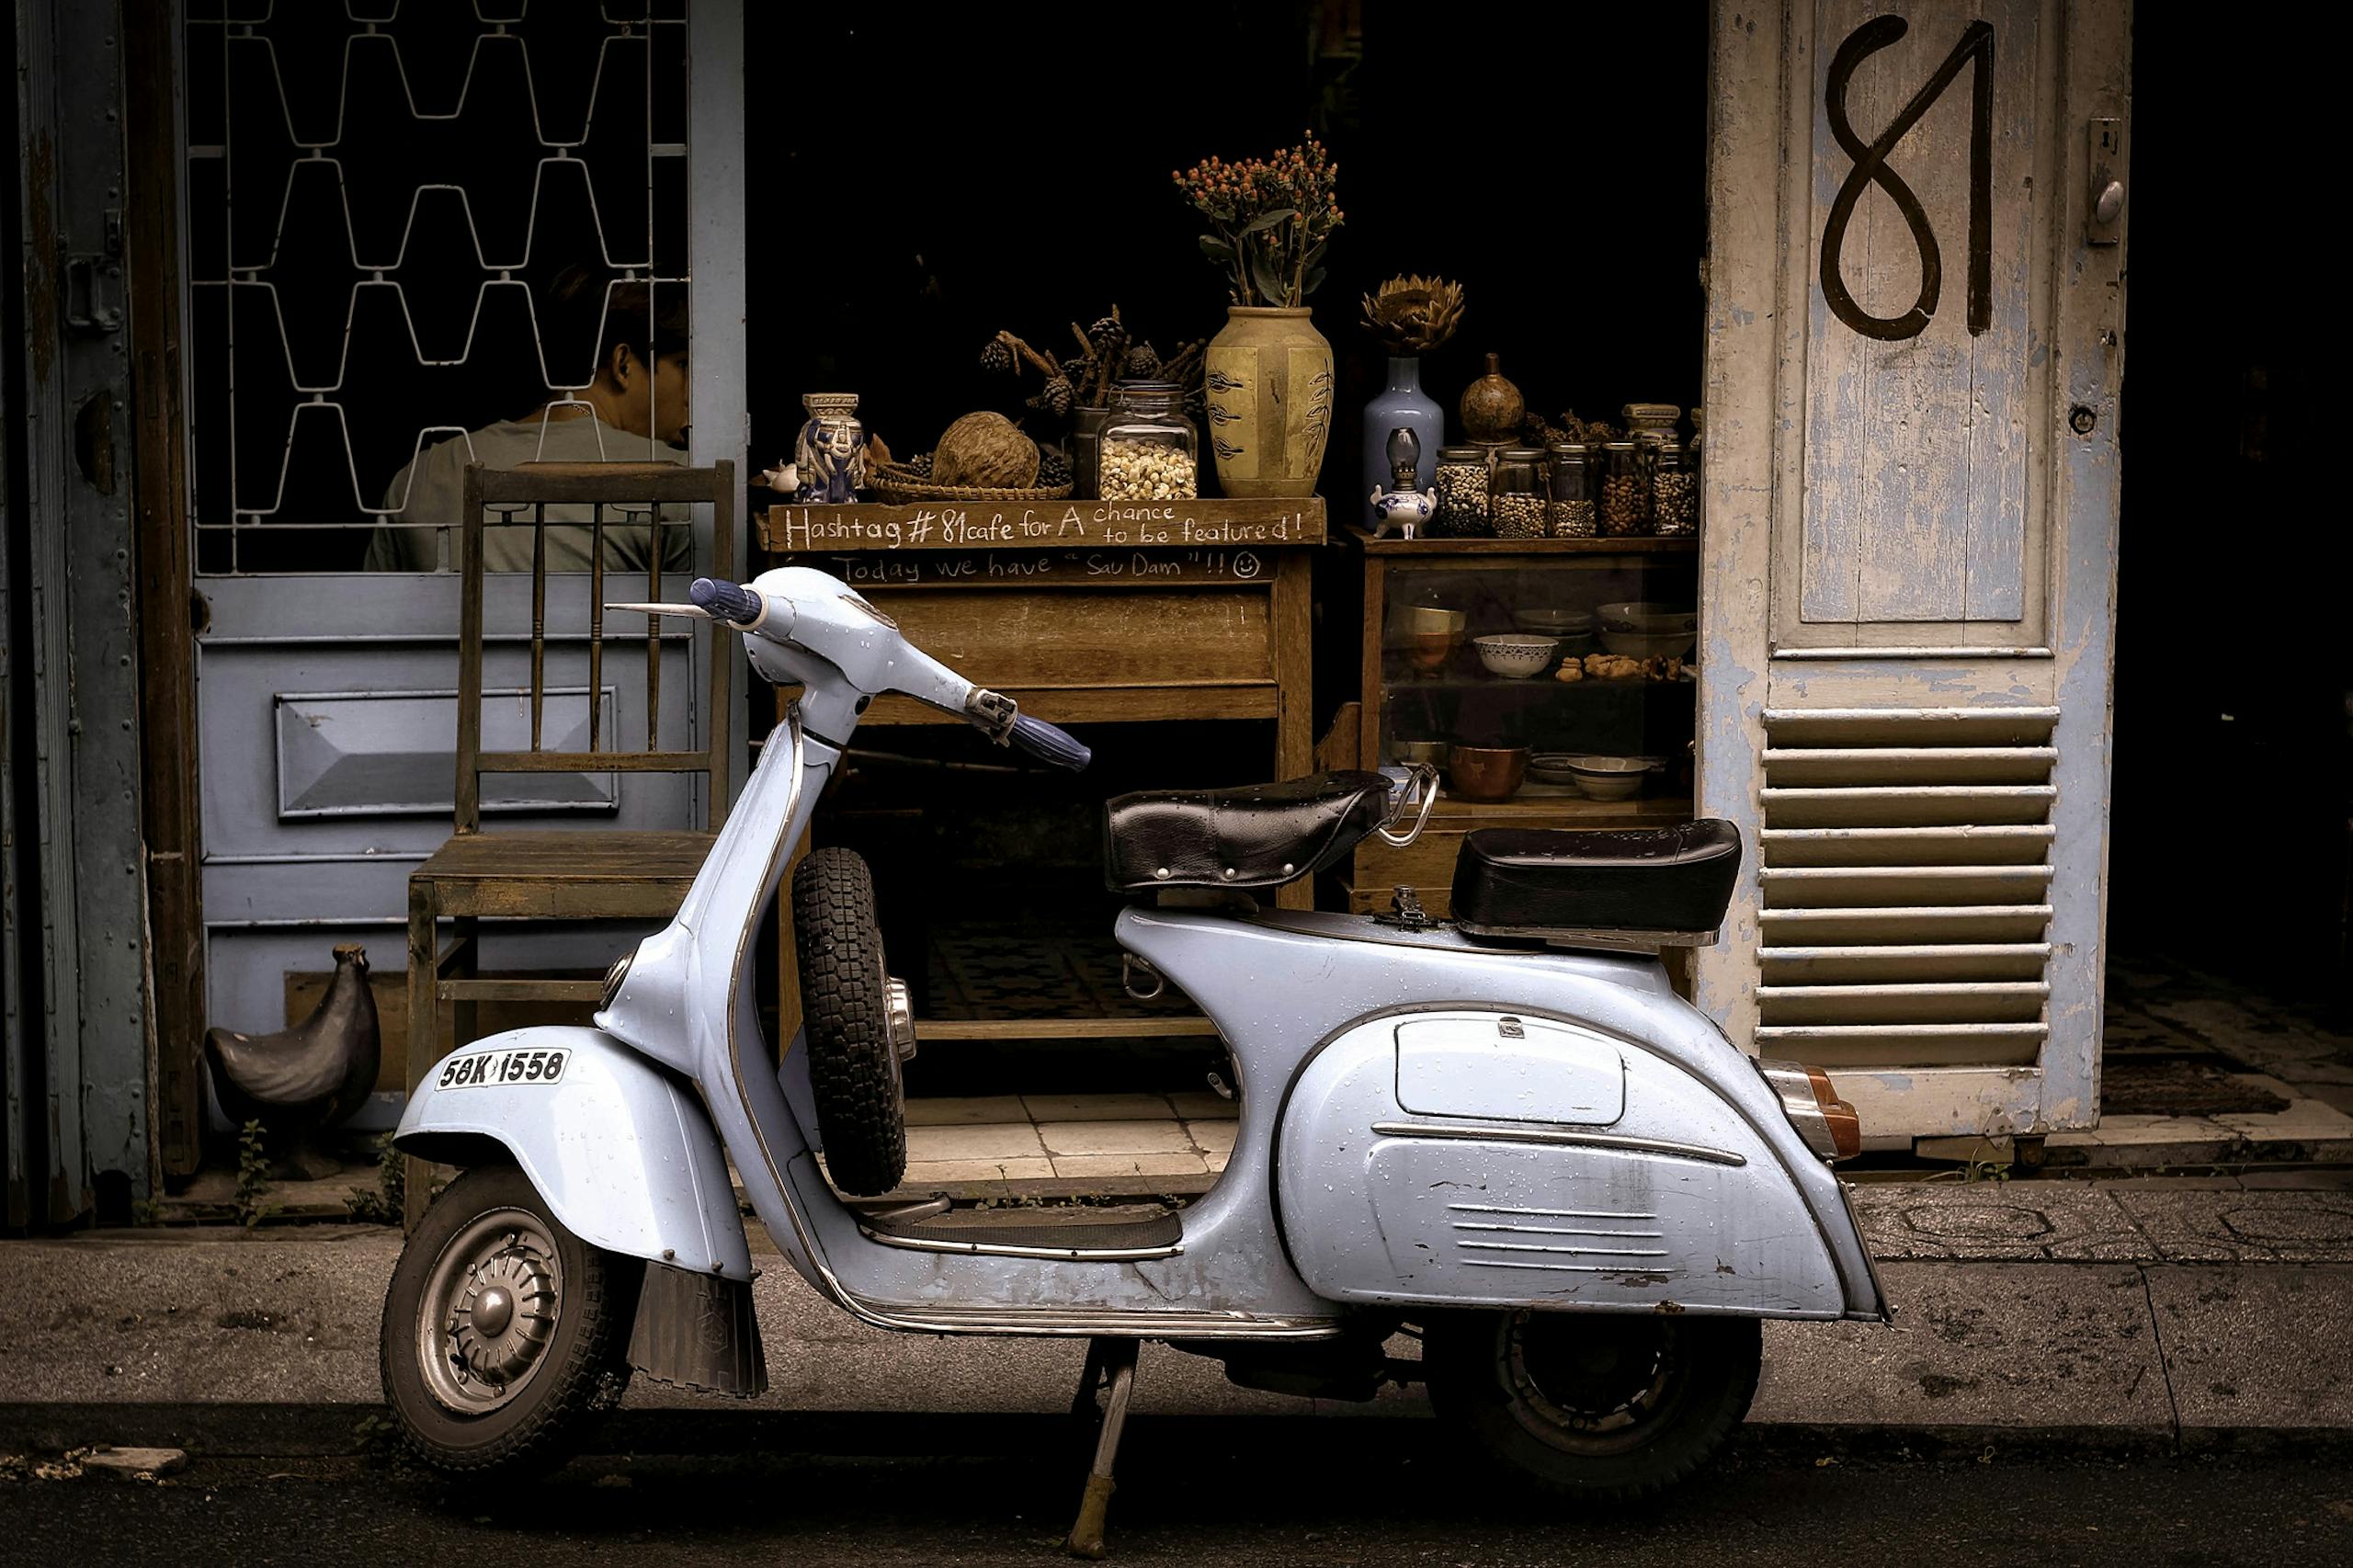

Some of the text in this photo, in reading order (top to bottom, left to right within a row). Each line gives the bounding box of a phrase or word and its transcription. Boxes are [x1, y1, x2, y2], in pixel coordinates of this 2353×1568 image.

[1820, 14, 1995, 341] 81
[786, 508, 902, 550] Hashtag
[1018, 509, 1051, 537] for
[1058, 506, 1086, 536] A
[1093, 501, 1176, 522] chance
[1103, 527, 1128, 543] to
[1141, 523, 1168, 543] be
[831, 556, 920, 583] Today
[934, 559, 977, 577] we
[989, 553, 1052, 577] have
[498, 1051, 563, 1082] 1558
